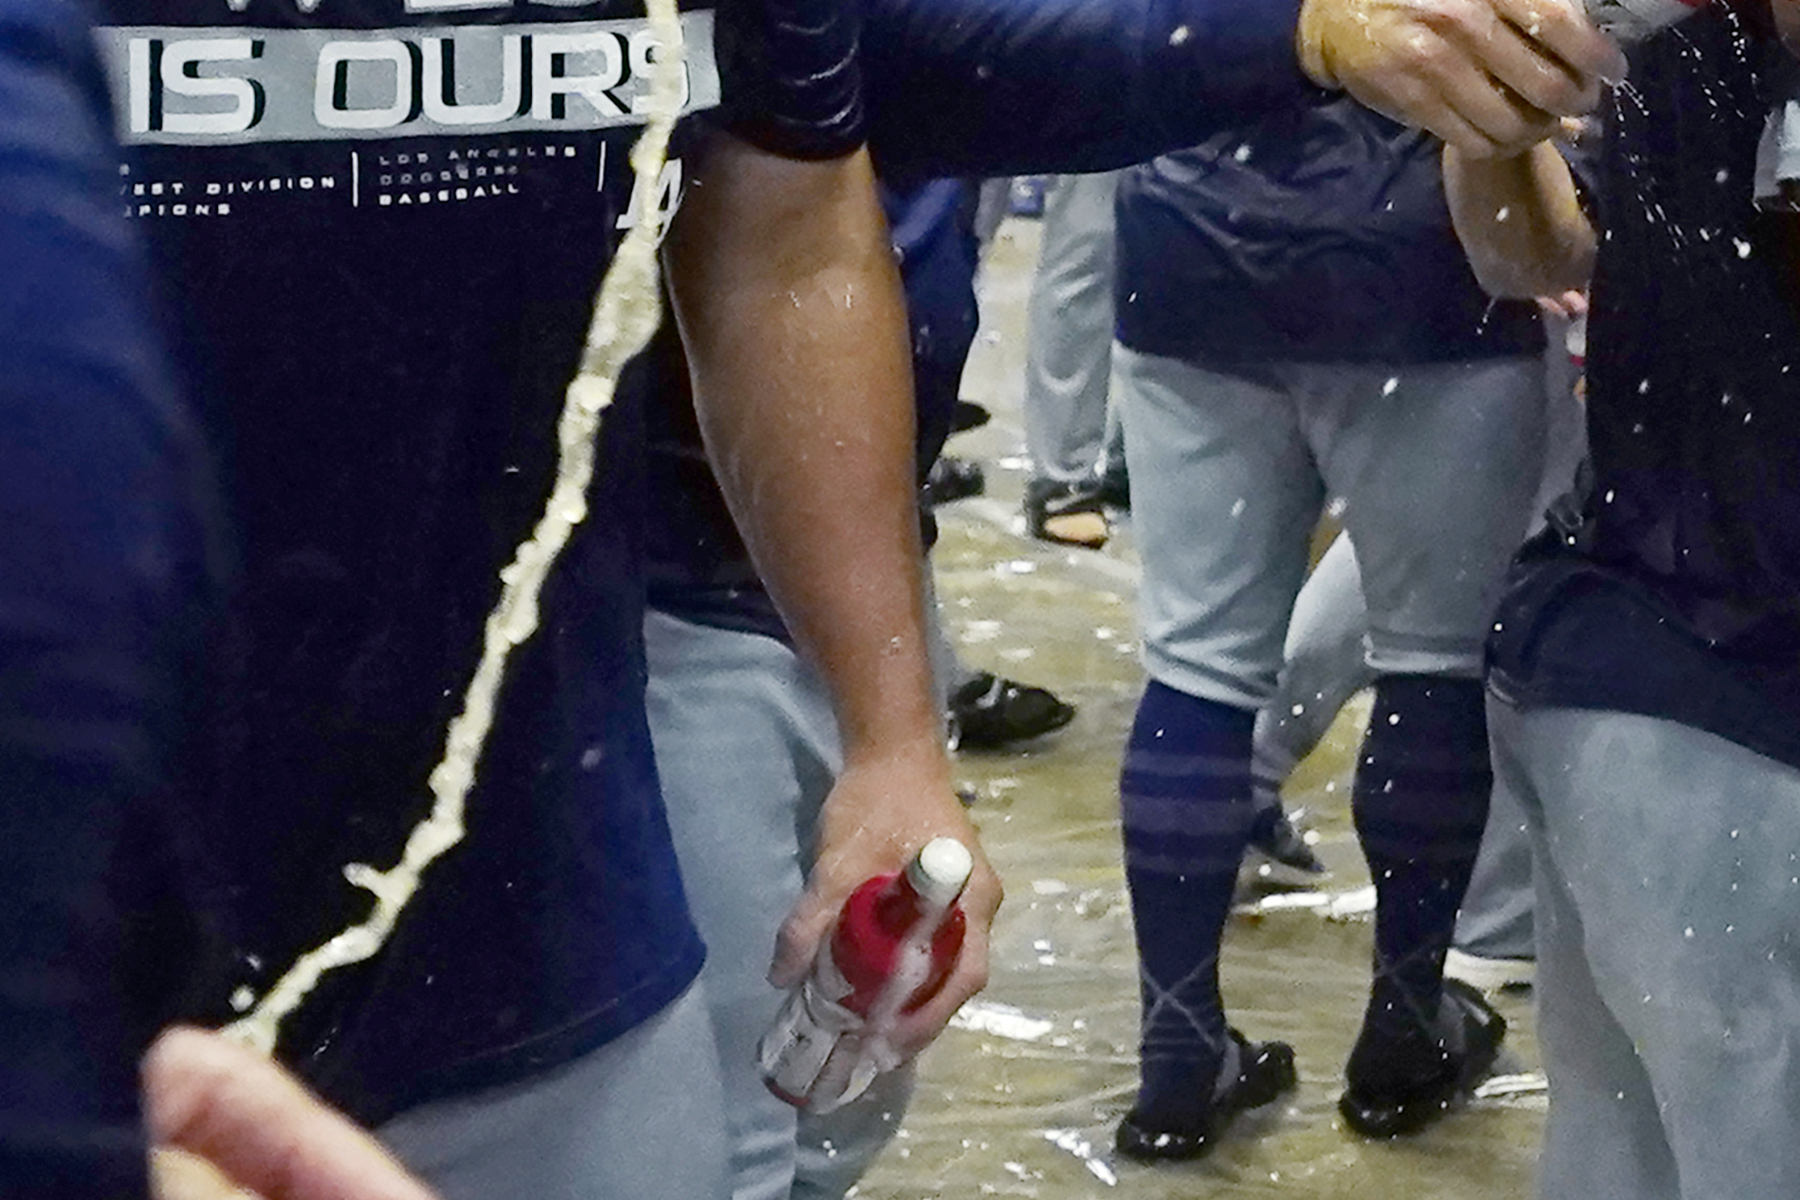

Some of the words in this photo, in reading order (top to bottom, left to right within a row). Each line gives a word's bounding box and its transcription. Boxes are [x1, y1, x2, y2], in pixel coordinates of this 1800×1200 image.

[129, 36, 264, 134] IS
[313, 28, 692, 131] OURS
[205, 175, 336, 197] DIVISION
[379, 183, 520, 206] BASEBALL
